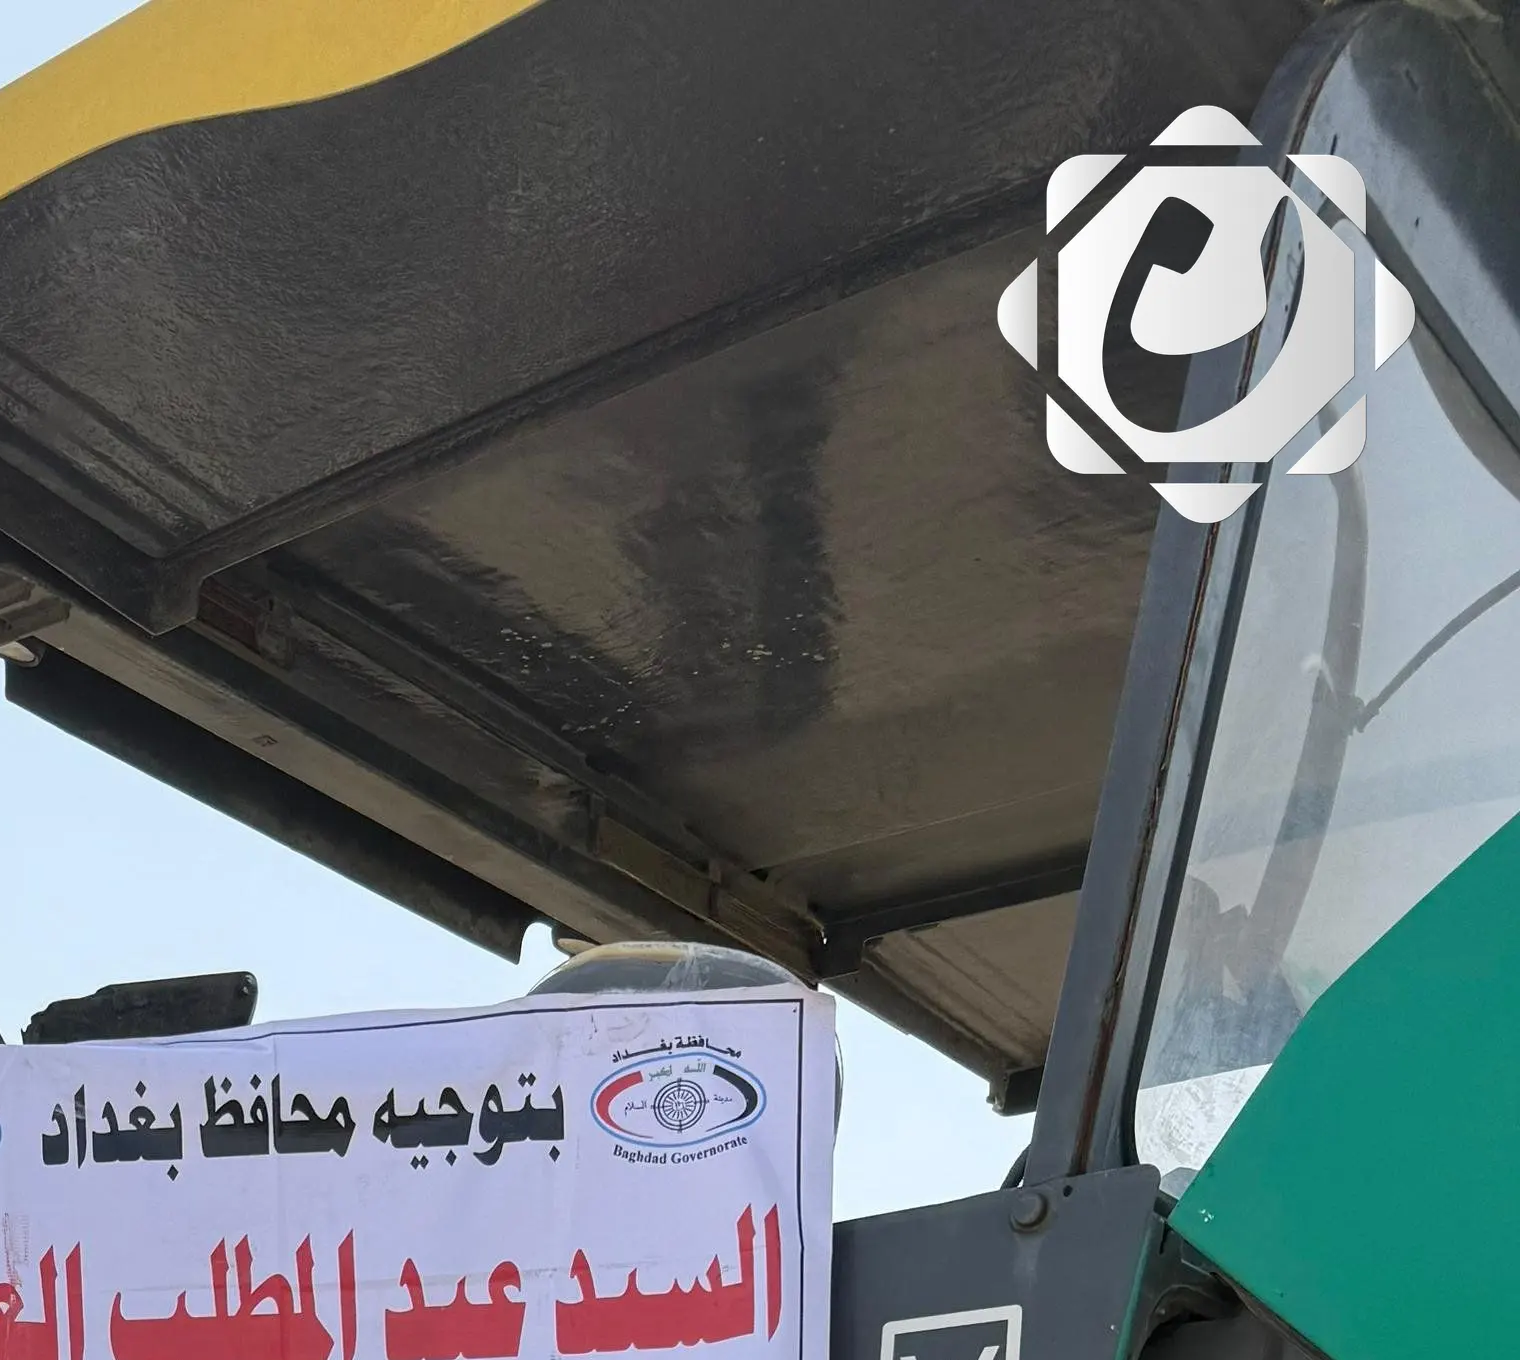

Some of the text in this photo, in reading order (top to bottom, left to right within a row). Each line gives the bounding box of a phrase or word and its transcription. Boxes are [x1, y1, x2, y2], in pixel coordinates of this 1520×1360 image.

[42, 1073, 564, 1180] بتوجيه محافظ بغداد
[612, 1136, 748, 1164] Baghdad Governorate
